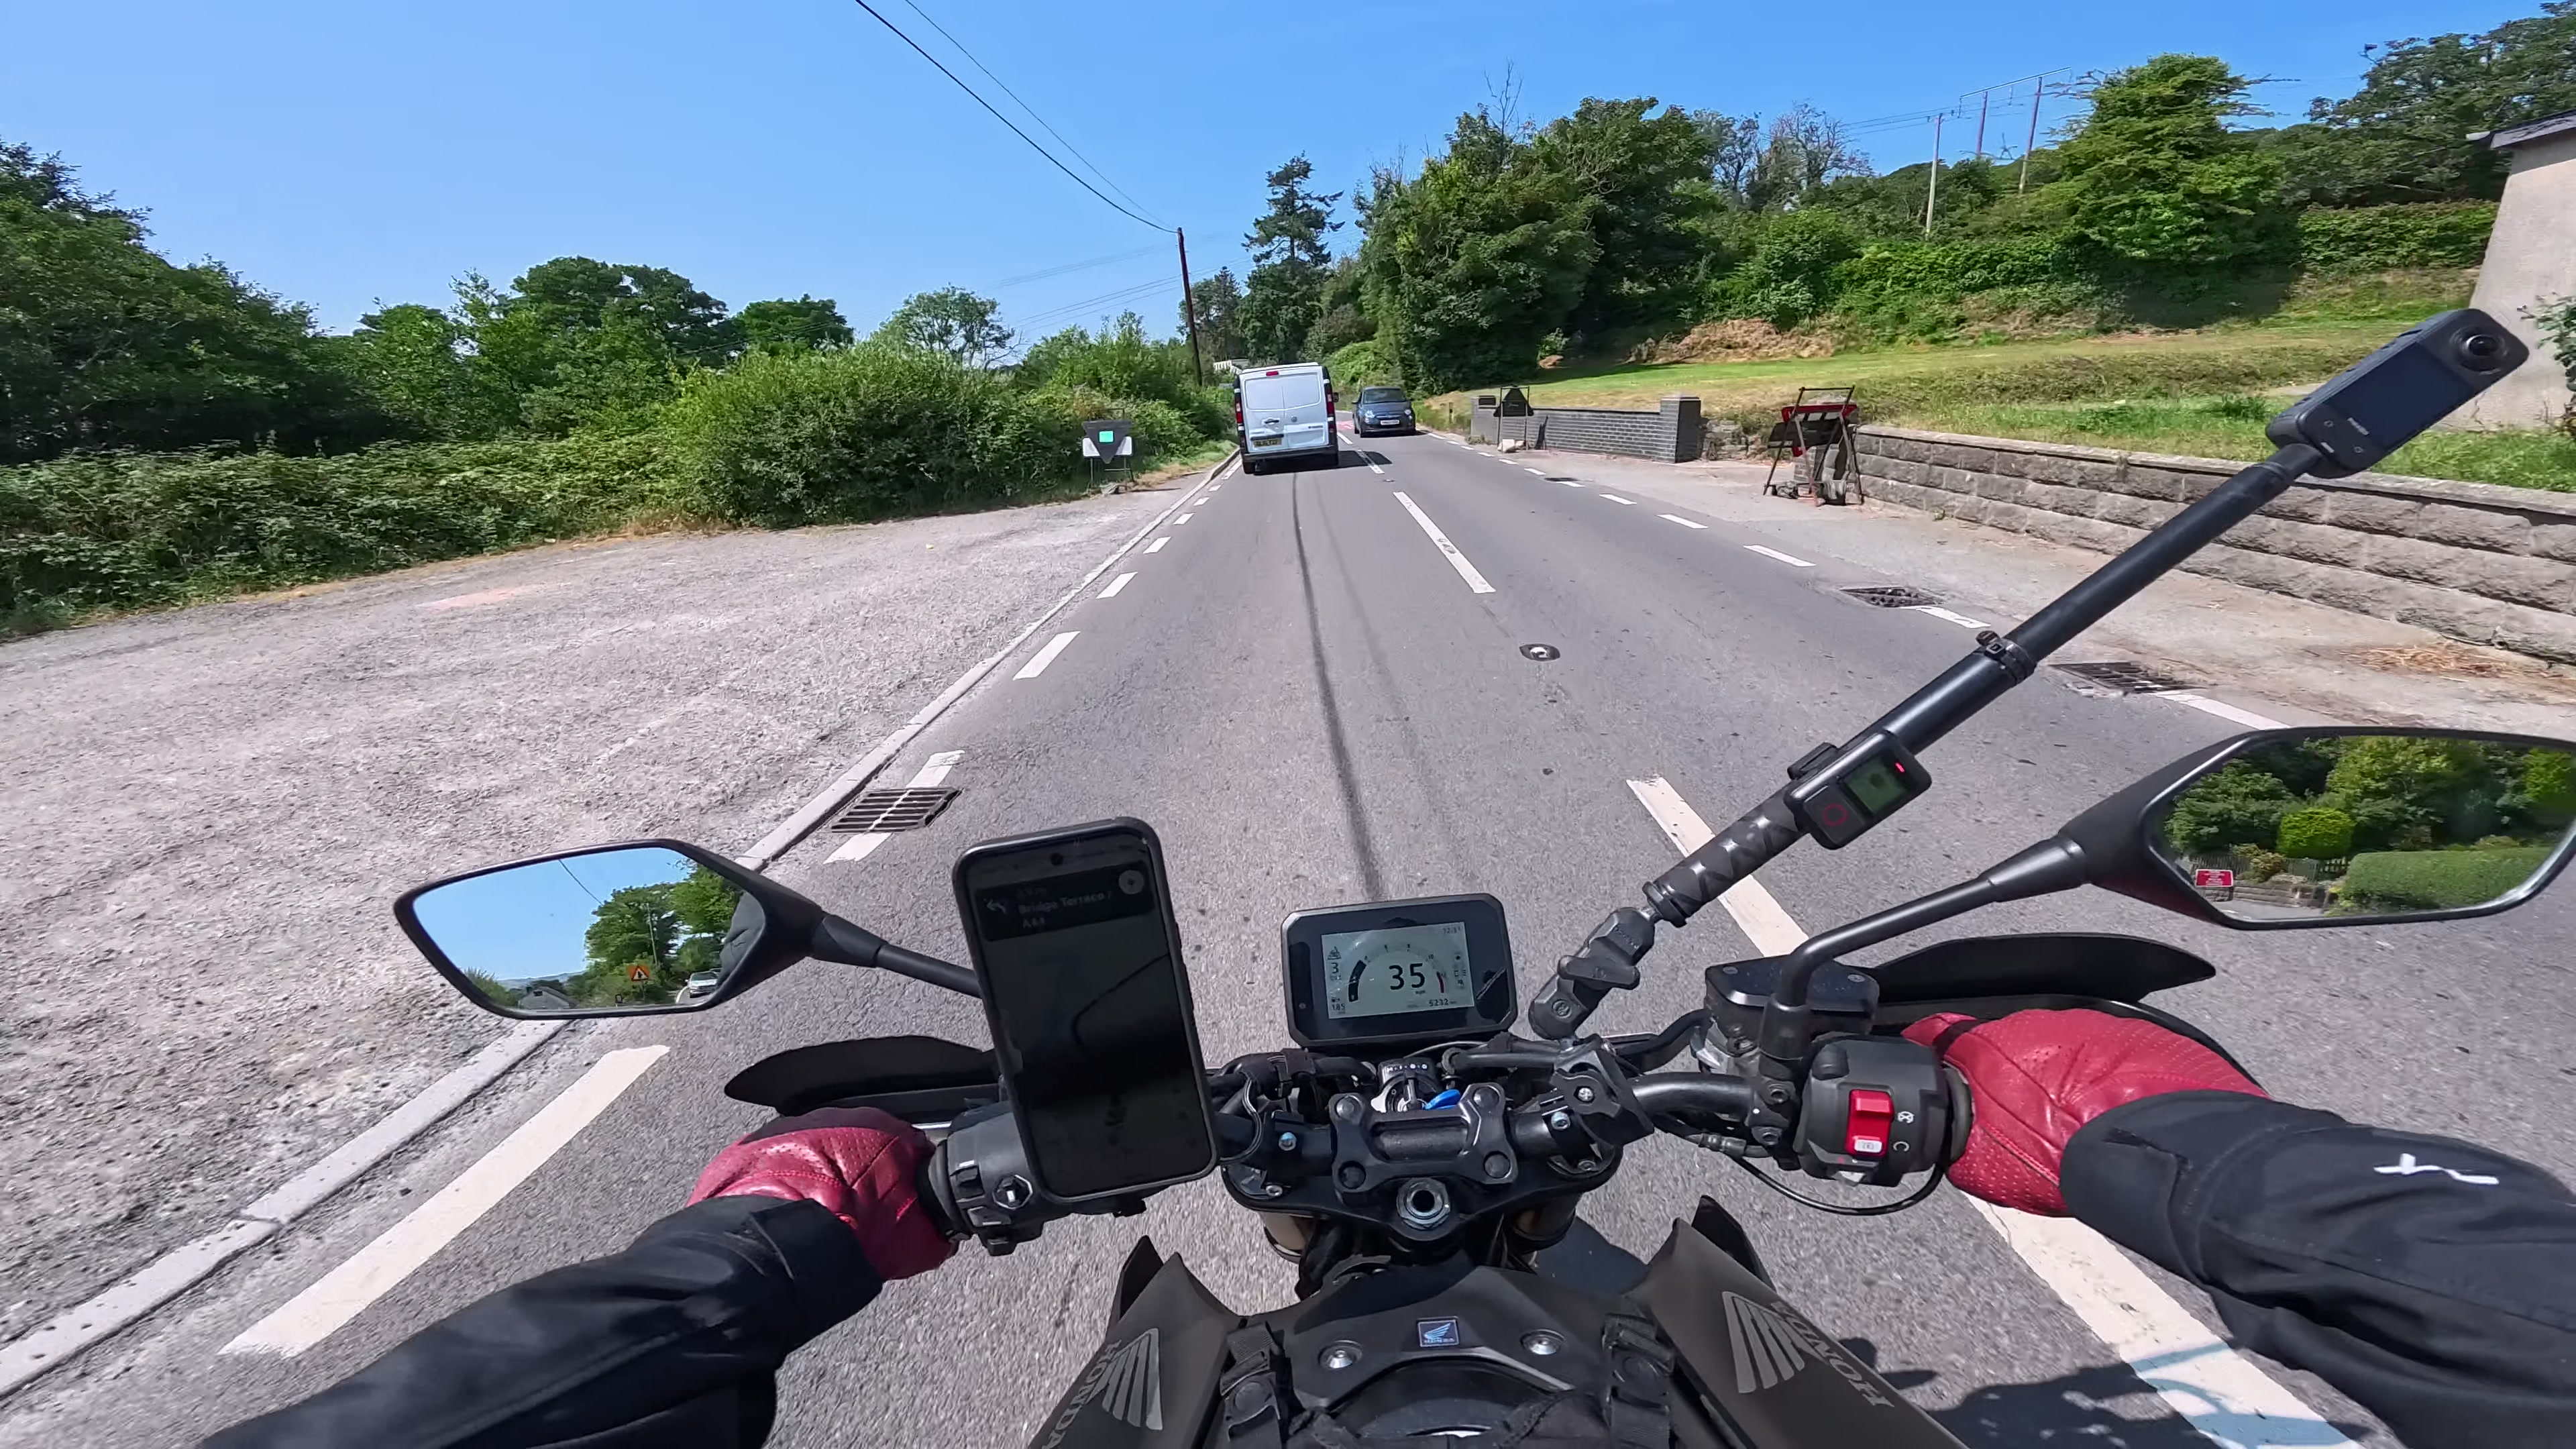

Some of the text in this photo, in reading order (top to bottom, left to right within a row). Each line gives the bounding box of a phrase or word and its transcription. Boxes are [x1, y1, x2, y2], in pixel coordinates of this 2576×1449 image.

[1331, 961, 1340, 974] 3
[1389, 963, 1426, 991] 35
[1771, 1301, 1895, 1407] HONDA
[1041, 1339, 1122, 1449] HONDA
